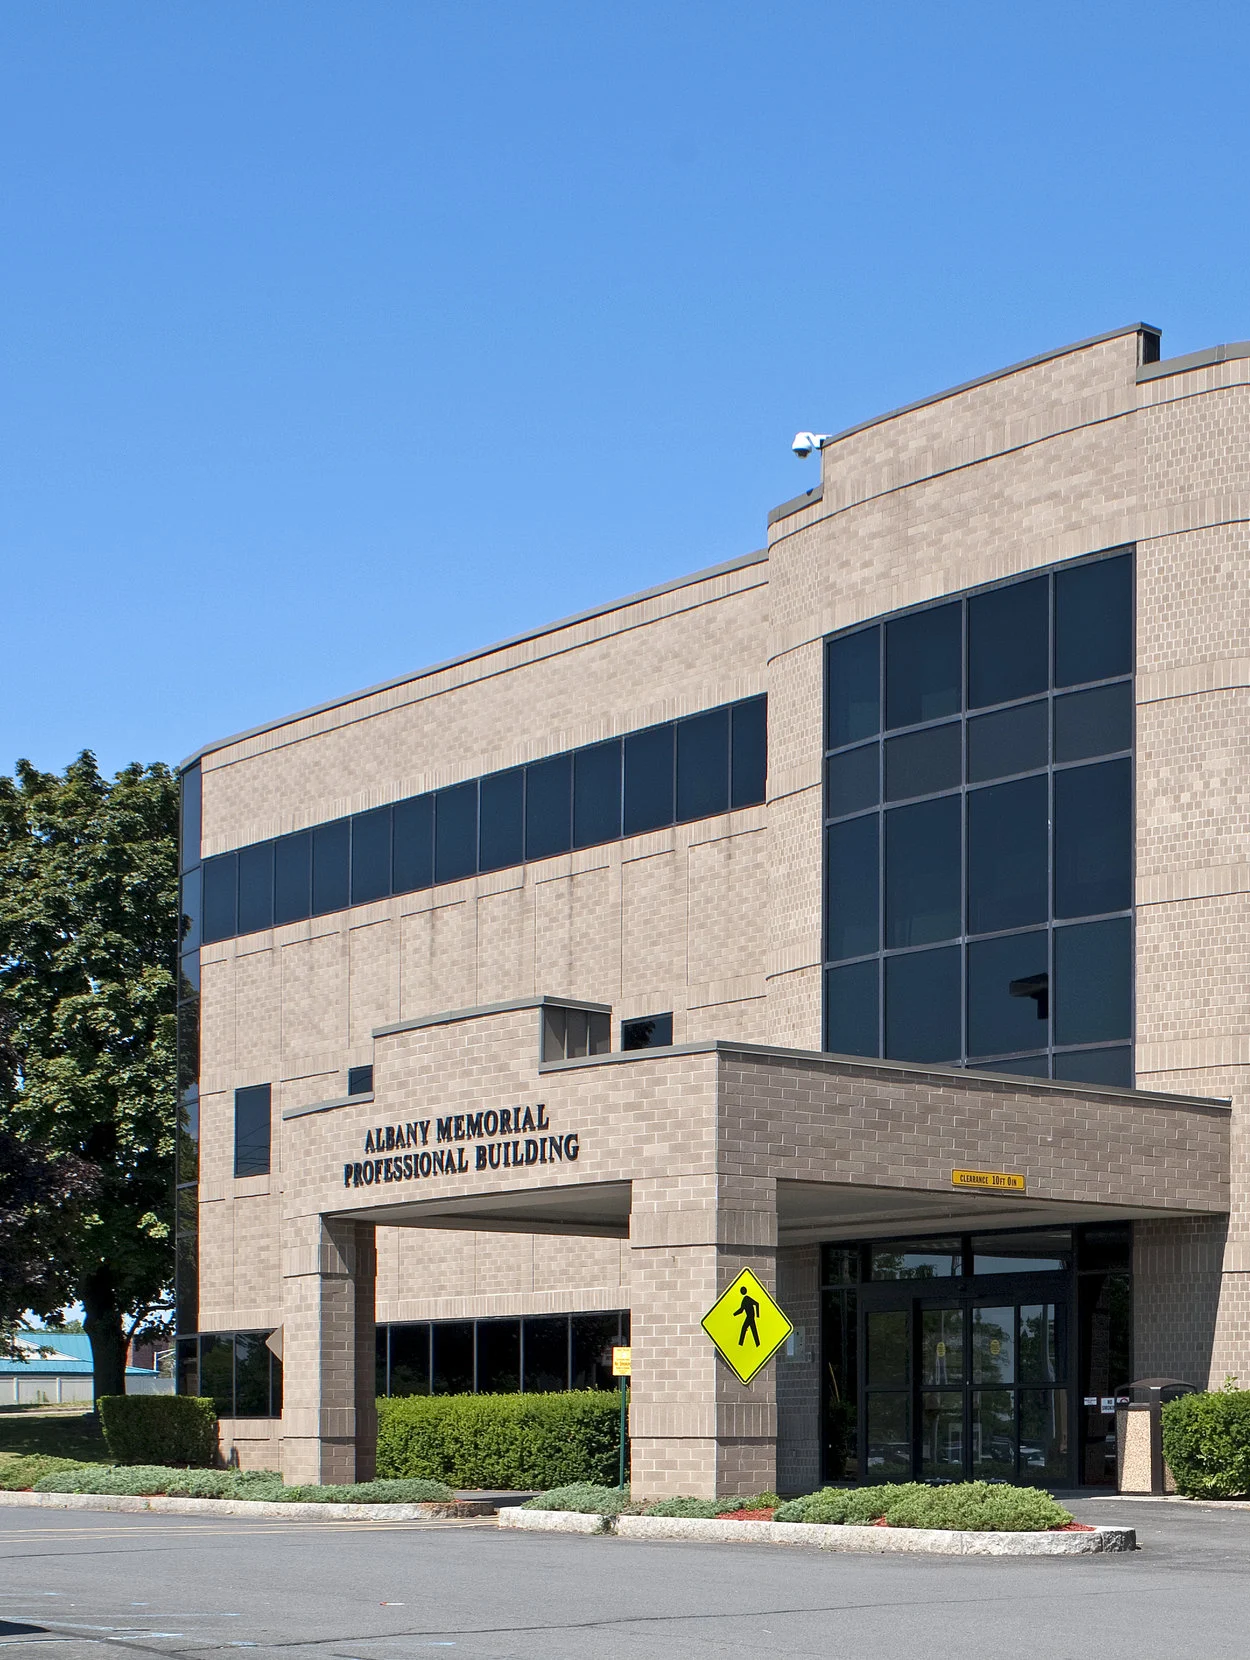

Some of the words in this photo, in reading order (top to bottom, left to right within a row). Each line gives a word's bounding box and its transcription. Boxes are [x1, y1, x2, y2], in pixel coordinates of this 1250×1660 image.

[364, 1120, 431, 1154] ALBANY
[436, 1104, 550, 1143] MEMORIAL
[343, 1147, 469, 1188] PROFESSIONAL
[475, 1134, 580, 1171] BUILDING
[960, 1174, 988, 1184] CLEARANCE
